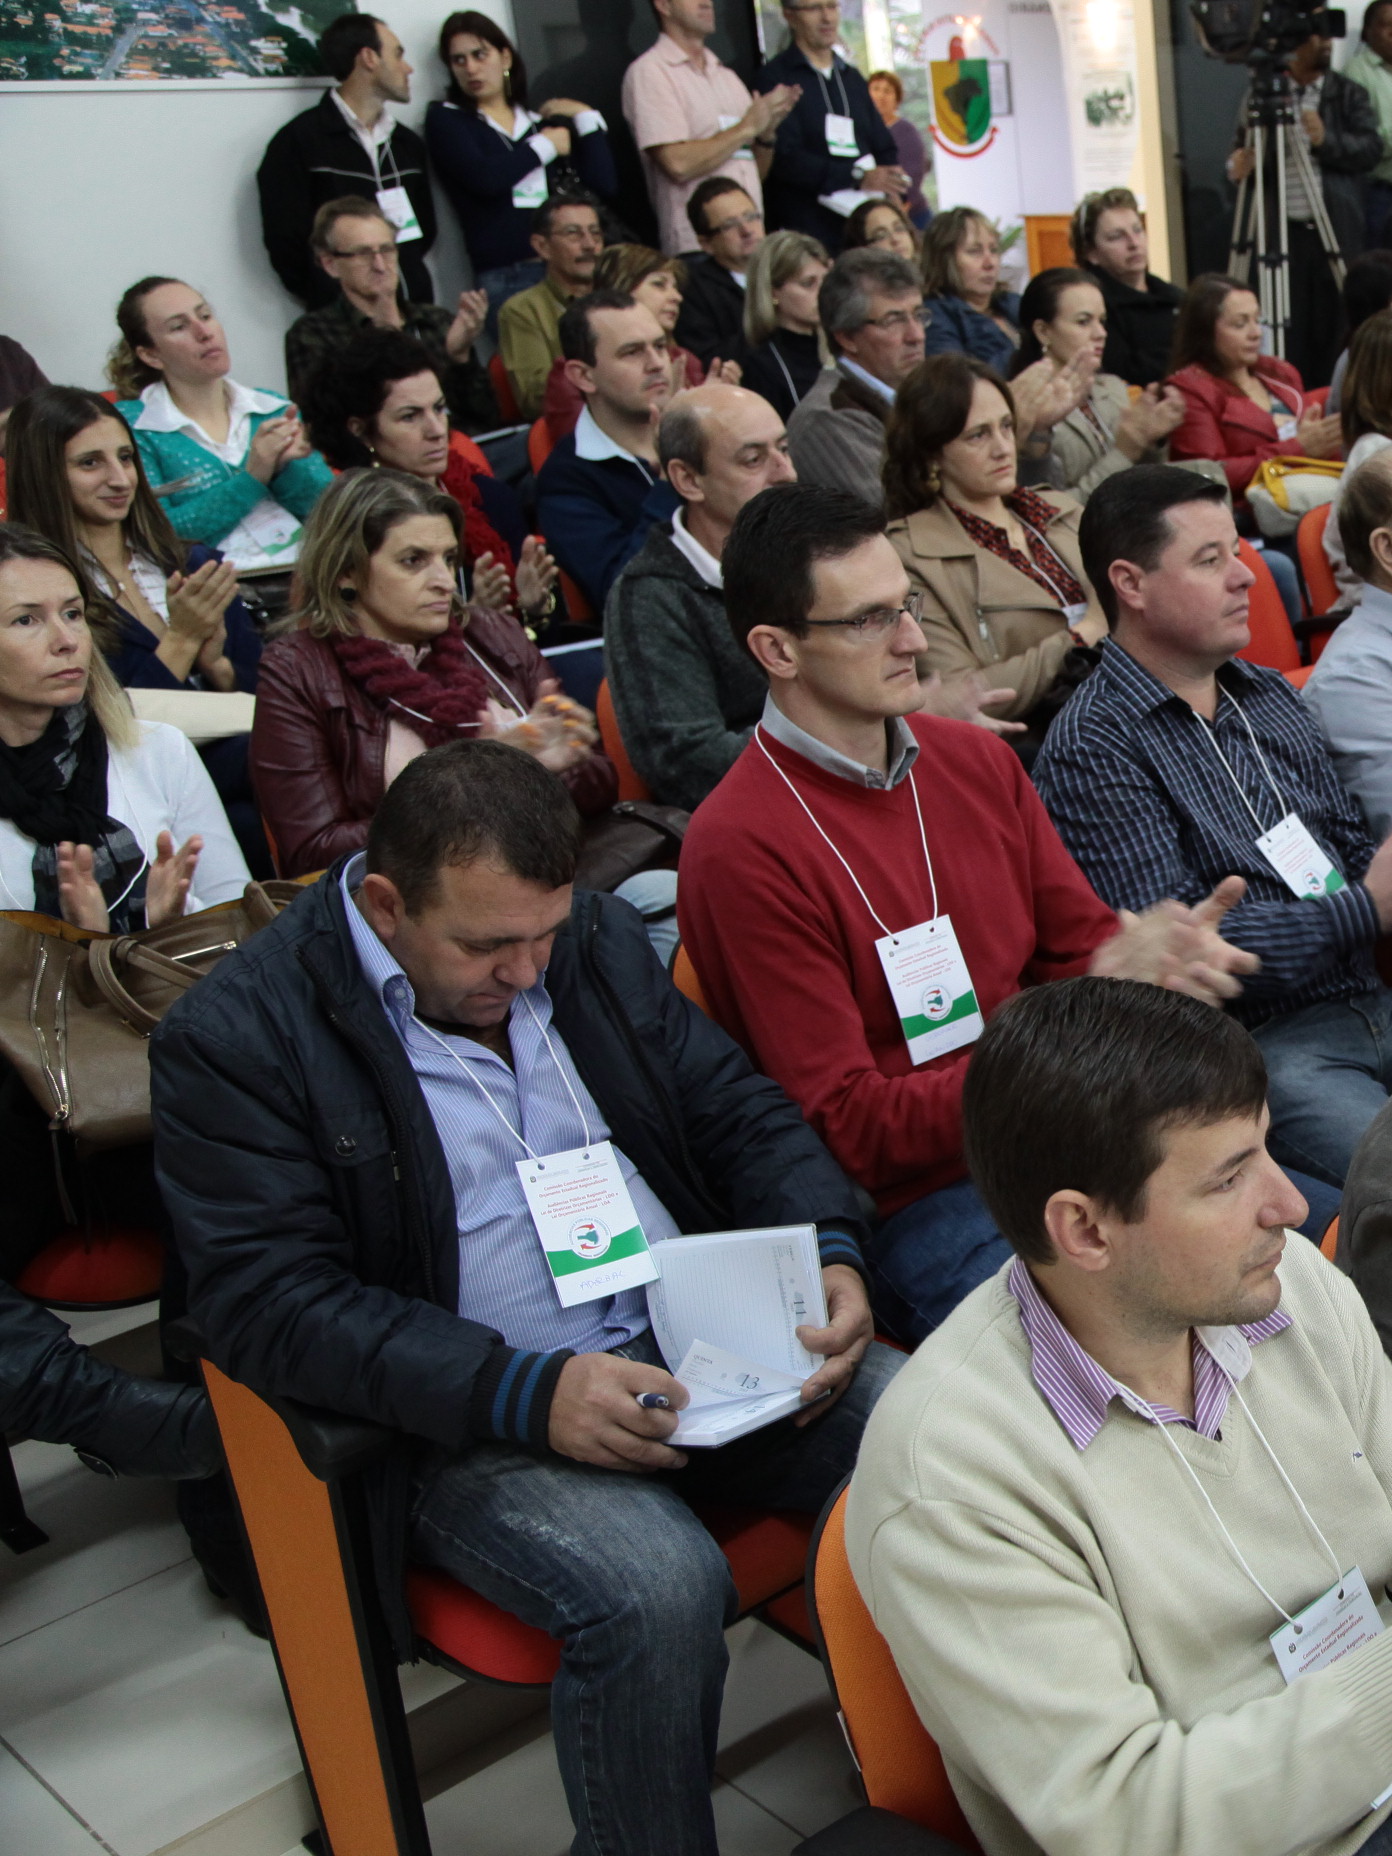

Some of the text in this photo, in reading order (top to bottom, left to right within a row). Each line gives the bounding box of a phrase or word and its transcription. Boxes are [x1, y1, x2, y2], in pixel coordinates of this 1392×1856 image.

[693, 1354, 713, 1365] QUINTA
[740, 1373, 760, 1389] 13
[1299, 1652, 1321, 1673] Orçamento
[1321, 1637, 1337, 1654] Estadual
[1337, 1615, 1363, 1639] Regionalizado
[1303, 1642, 1321, 1660] Comissão
[1322, 1619, 1348, 1644] Coordenadora
[1330, 1649, 1347, 1663] Públicas
[1347, 1632, 1366, 1649] Regionais
